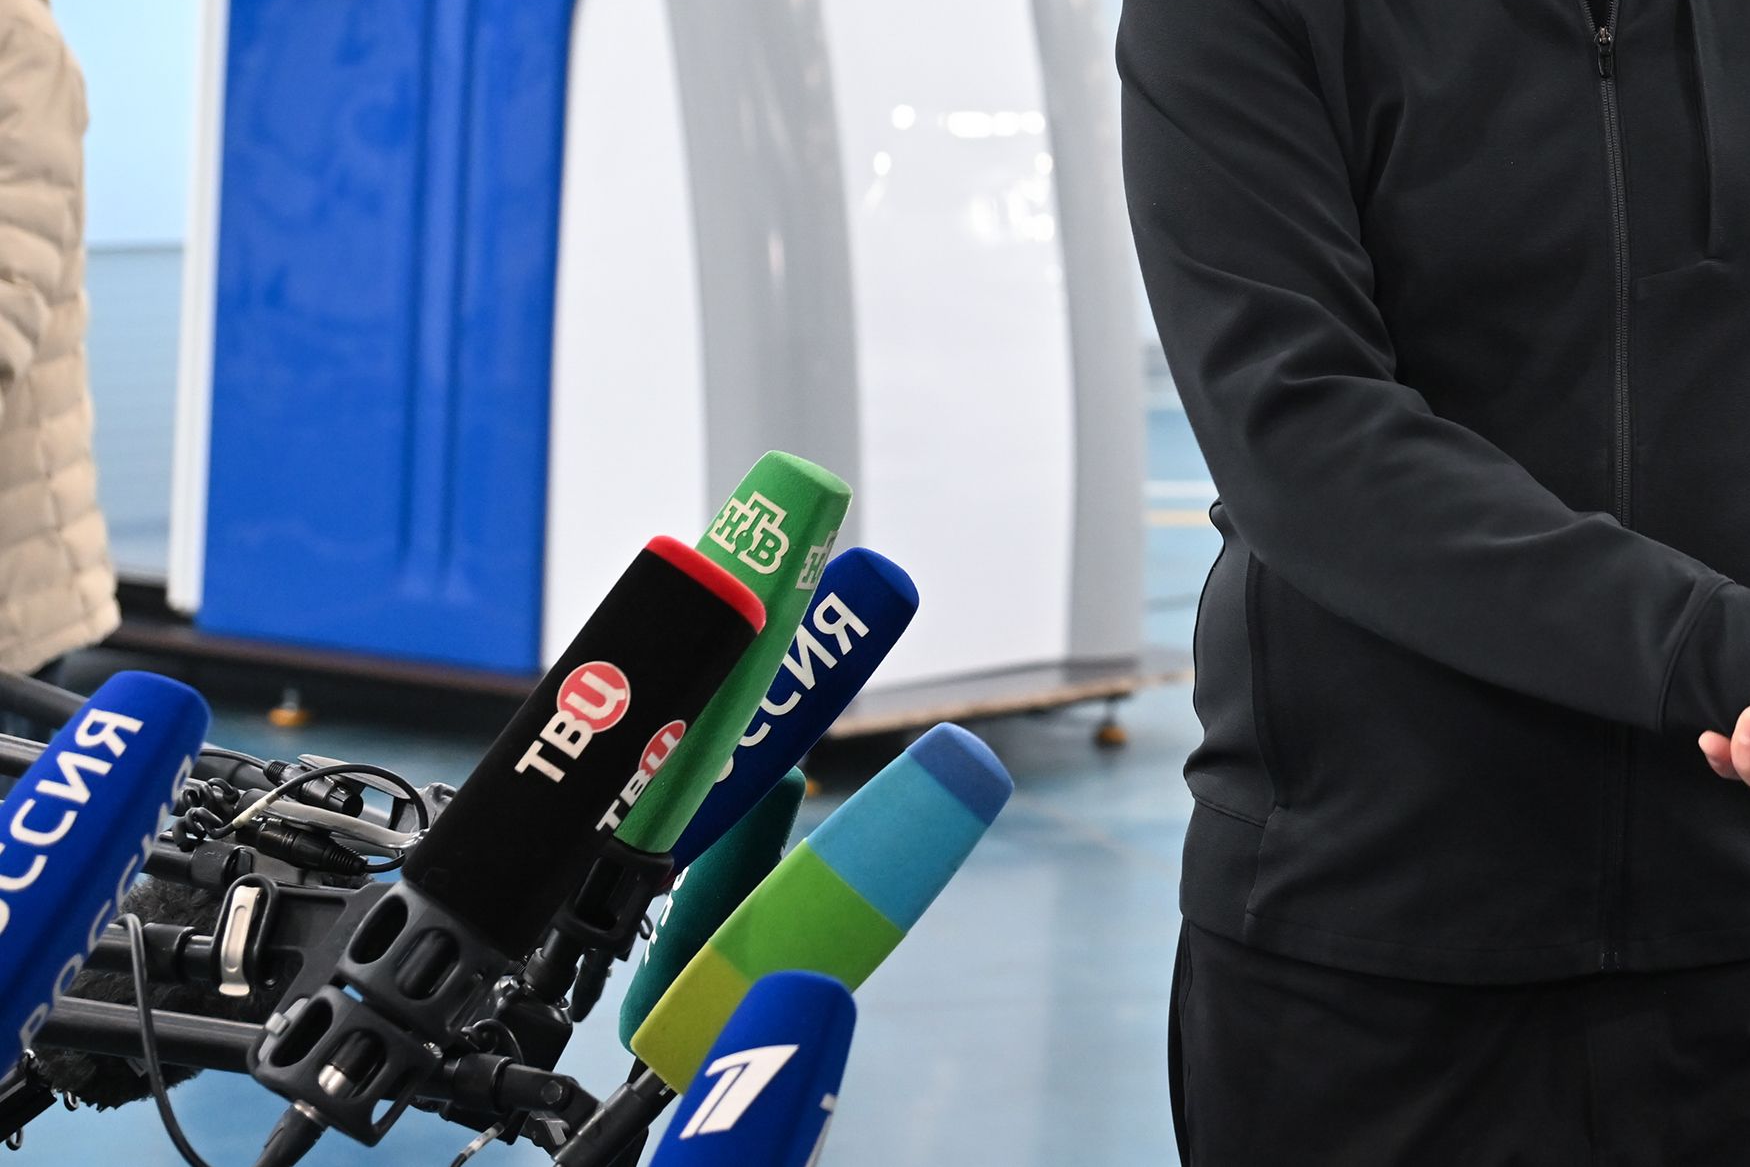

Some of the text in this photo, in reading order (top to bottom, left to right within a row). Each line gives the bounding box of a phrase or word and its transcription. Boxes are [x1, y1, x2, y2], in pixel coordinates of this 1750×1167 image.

[708, 490, 790, 575] НТВ
[514, 660, 631, 783] ТВЦ
[714, 591, 870, 783] ССИЯ
[0, 708, 144, 934] ССИЯ
